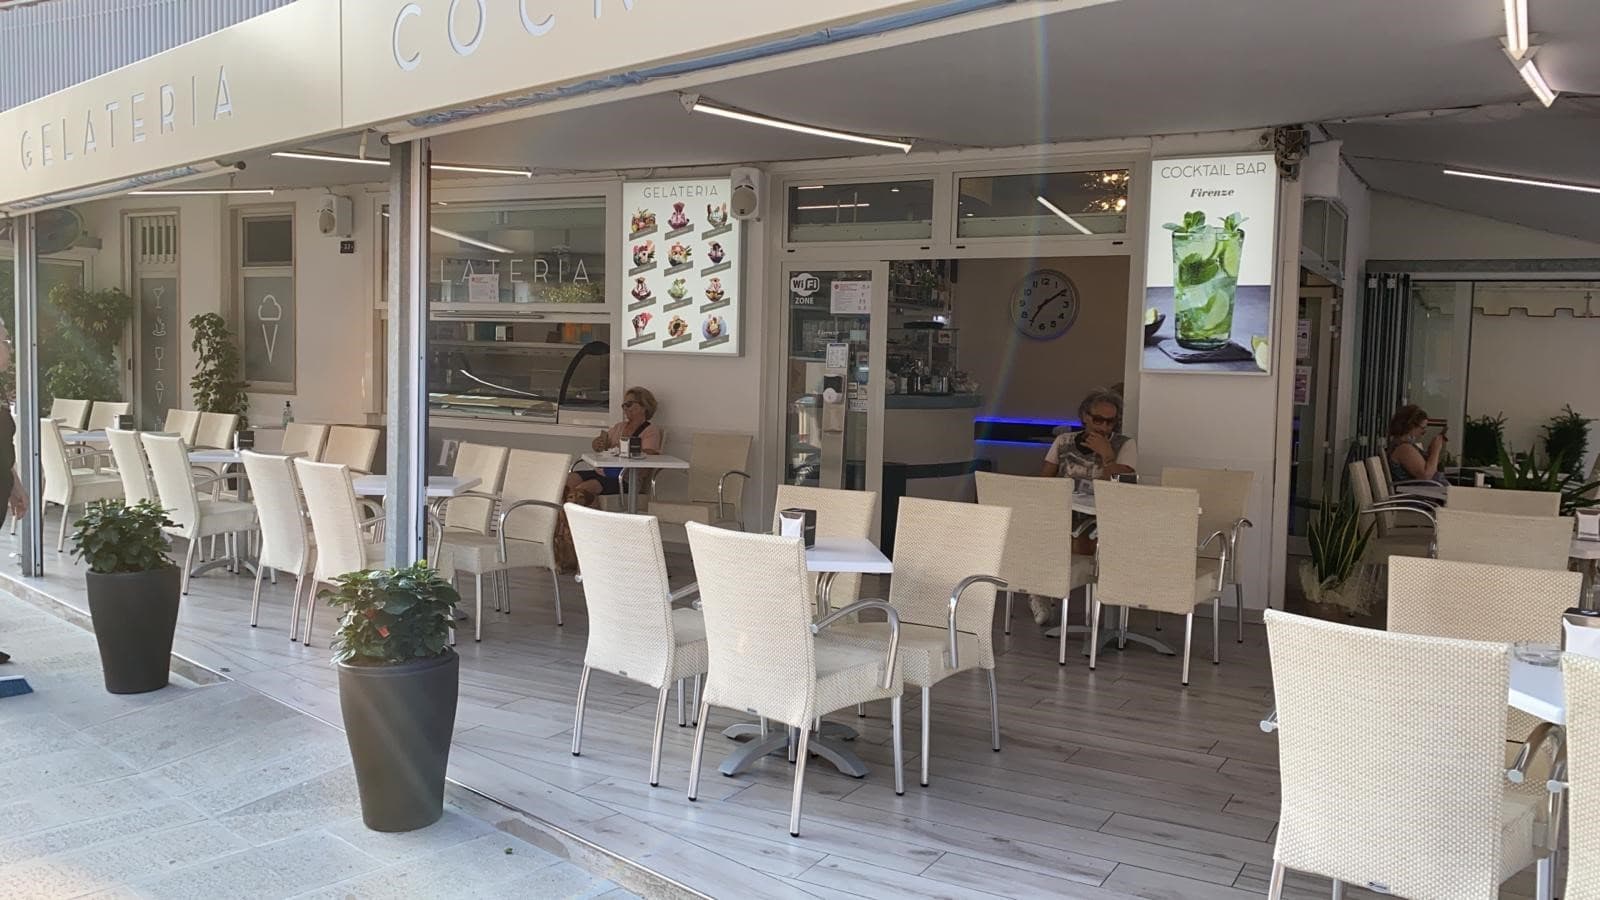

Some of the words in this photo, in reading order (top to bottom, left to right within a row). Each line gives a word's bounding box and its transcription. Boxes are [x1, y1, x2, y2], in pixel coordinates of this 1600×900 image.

[20, 64, 233, 171] GELATERIA
[1160, 163, 1231, 179] COCKTAIL
[1235, 161, 1267, 176] BAR
[642, 185, 719, 199] GELATERIA
[1189, 188, 1235, 198] Firenze
[794, 297, 814, 305] ZONE
